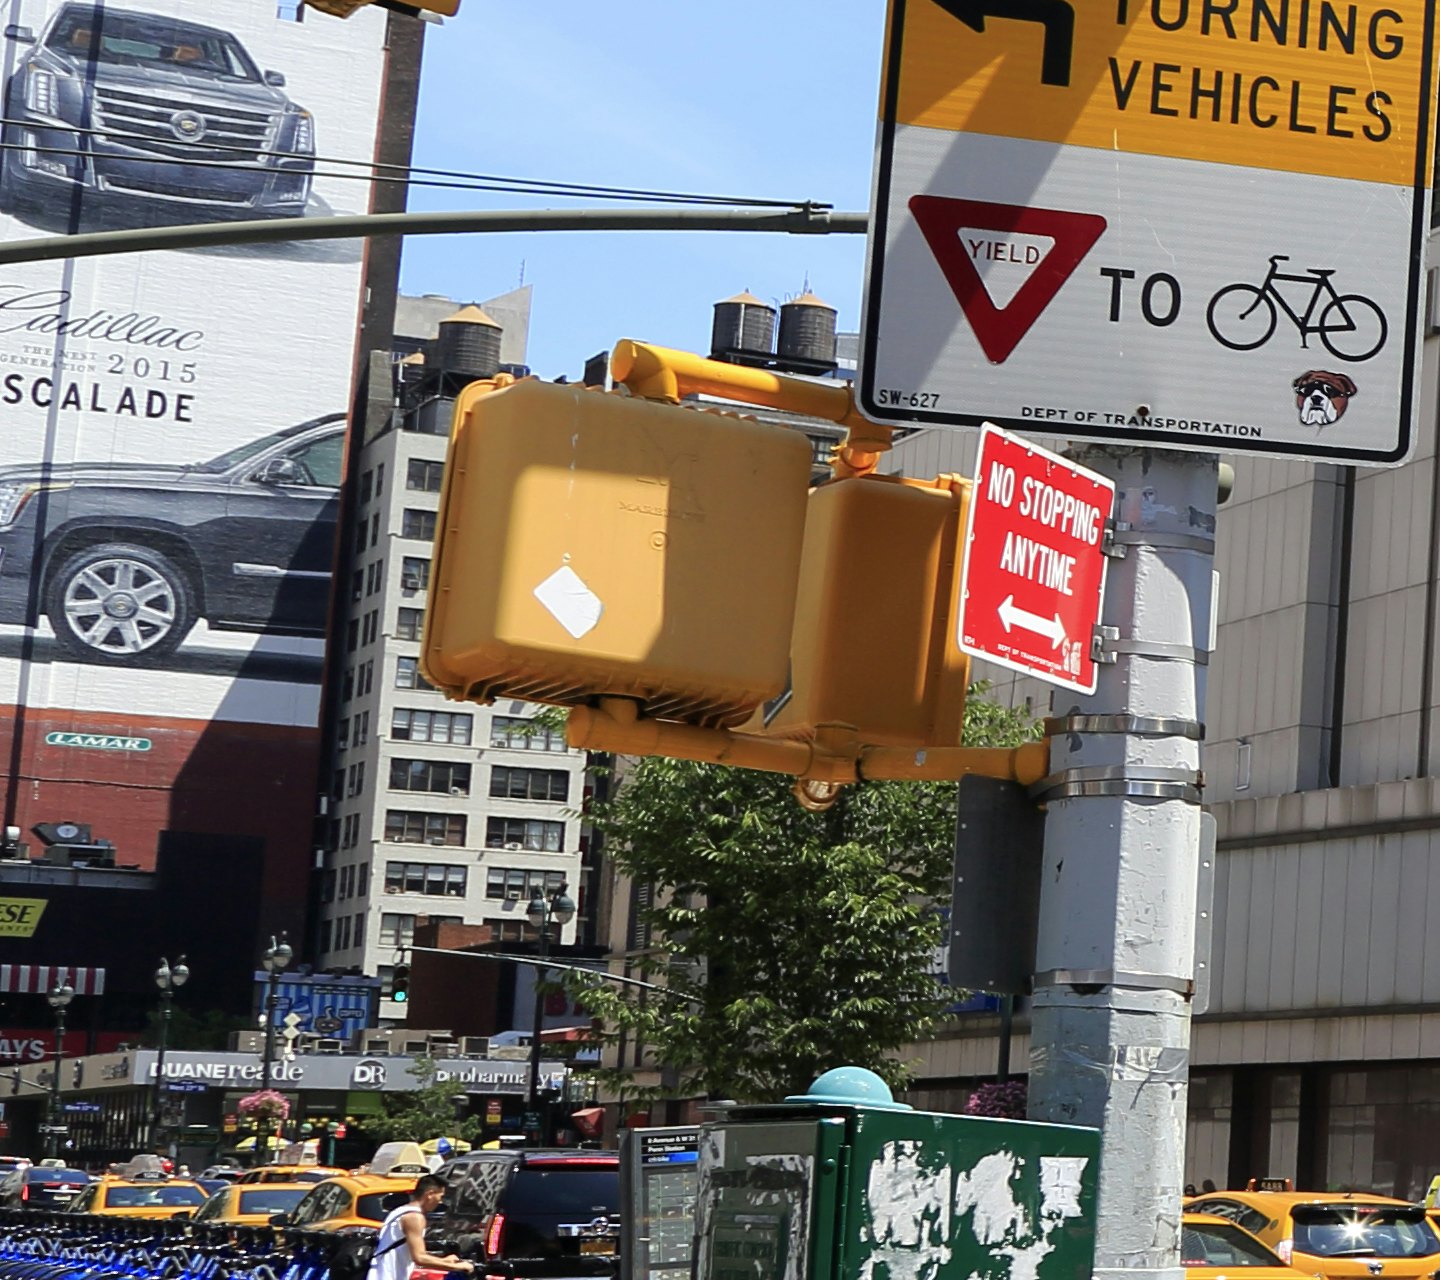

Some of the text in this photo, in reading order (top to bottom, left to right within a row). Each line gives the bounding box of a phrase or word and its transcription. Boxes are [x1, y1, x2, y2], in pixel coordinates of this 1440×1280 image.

[1109, 57, 1393, 144] VEHICLES
[968, 238, 1041, 267] YIELD
[1100, 266, 1182, 328] TO
[107, 353, 197, 384] 2015
[878, 389, 940, 409] SW-627
[1021, 406, 1263, 438] DEPT OF TRANSPORTATION
[987, 461, 1100, 546] NO STOPPING
[1000, 531, 1076, 597] ANYTIME
[54, 734, 141, 749] LAMAR
[354, 1066, 387, 1084] DR
[460, 1068, 550, 1088] pharmay
